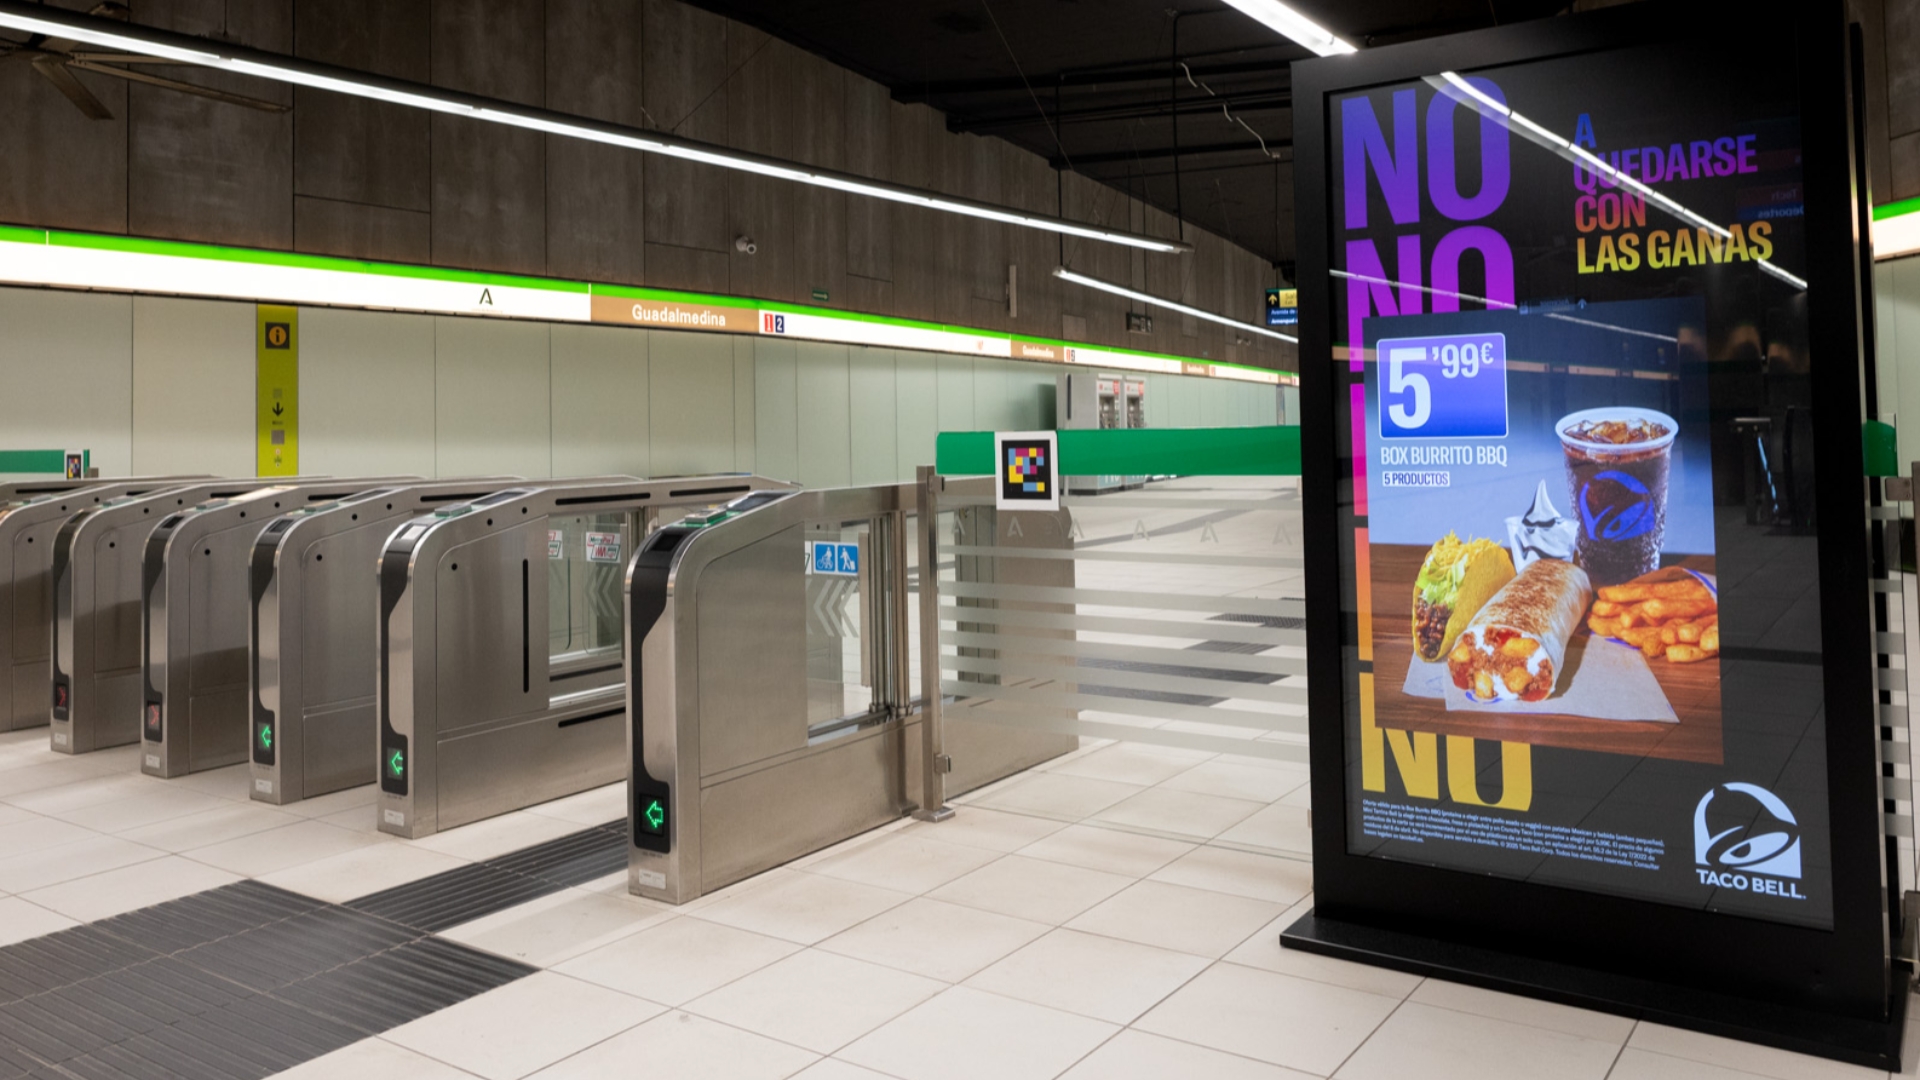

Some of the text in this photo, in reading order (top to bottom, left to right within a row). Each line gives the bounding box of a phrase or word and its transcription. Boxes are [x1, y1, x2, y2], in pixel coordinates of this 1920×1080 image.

[1574, 113, 1597, 150] A
[1341, 76, 1511, 230] NO
[1573, 134, 1758, 195] QUEDARSE
[1575, 190, 1646, 233] CON
[1577, 221, 1773, 274] LAS GANAS
[632, 304, 726, 326] Guadalmedina
[1381, 445, 1507, 467] BOX BURRITO BBQ
[1384, 472, 1449, 485] 5 PRODUCTOS
[1695, 868, 1748, 890] TACO
